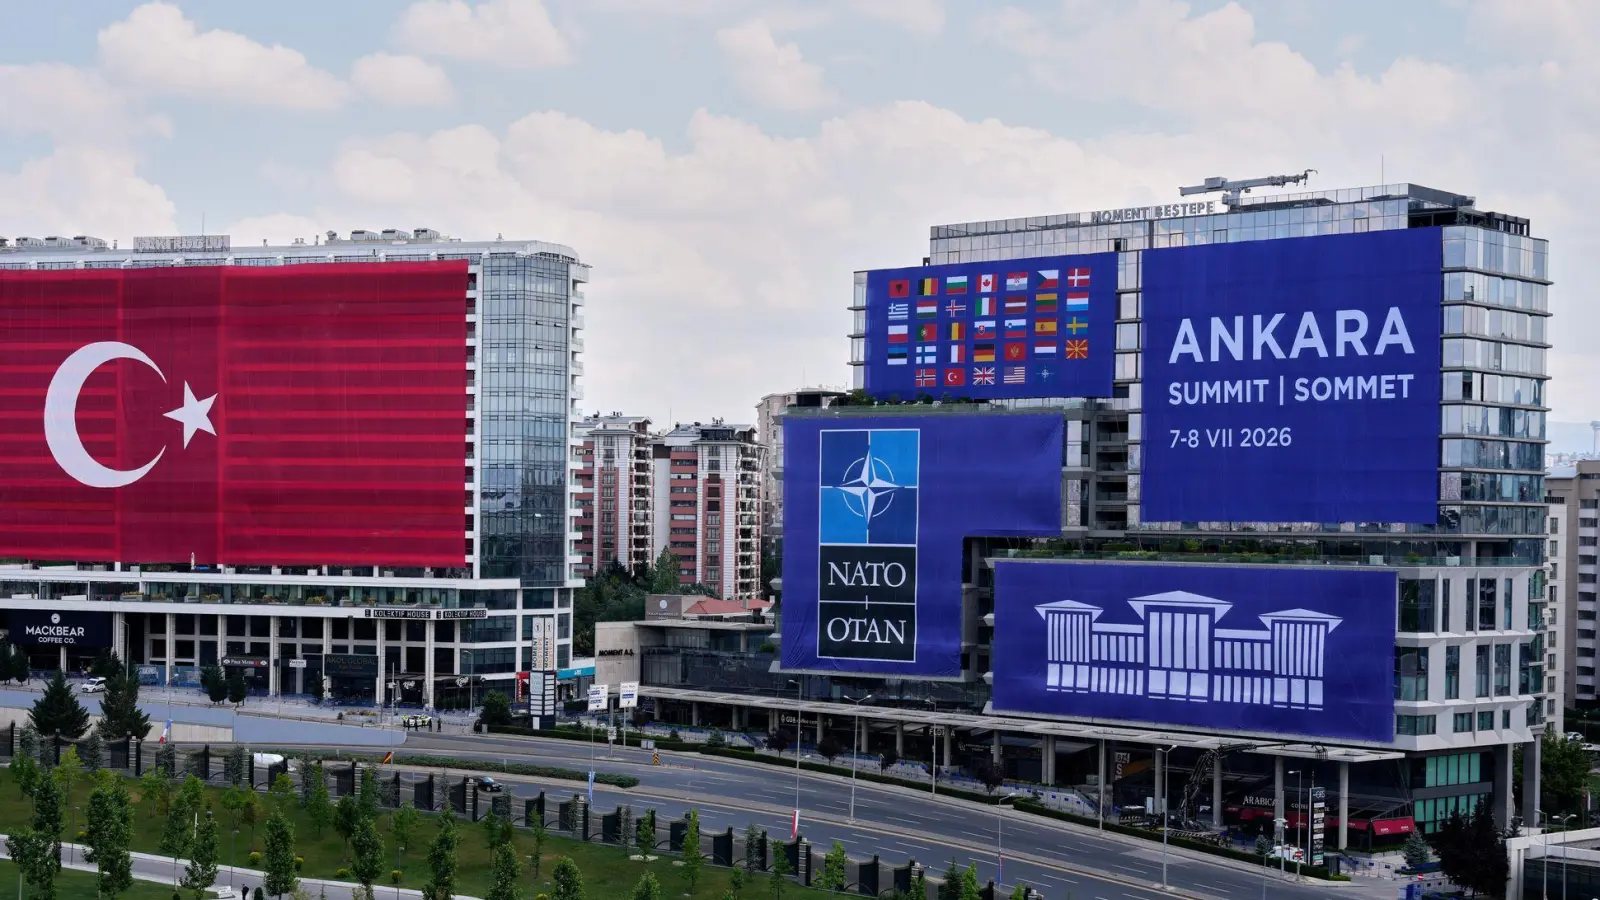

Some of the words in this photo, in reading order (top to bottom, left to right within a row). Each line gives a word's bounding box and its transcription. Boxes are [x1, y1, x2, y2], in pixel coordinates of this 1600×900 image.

[1091, 207, 1150, 223] MOMENT
[1169, 307, 1414, 363] ANKARA
[1169, 380, 1269, 405] SUMMIT
[1294, 374, 1414, 402] SOMMET
[1170, 429, 1199, 448] 7-8
[1206, 429, 1232, 447] VII
[1240, 427, 1292, 447] 2026
[828, 561, 906, 588] NATO
[407, 610, 429, 618] HOUSE
[26, 625, 84, 637] MACKBEAR
[38, 636, 63, 644] COFFEE
[828, 617, 906, 645] OTAN
